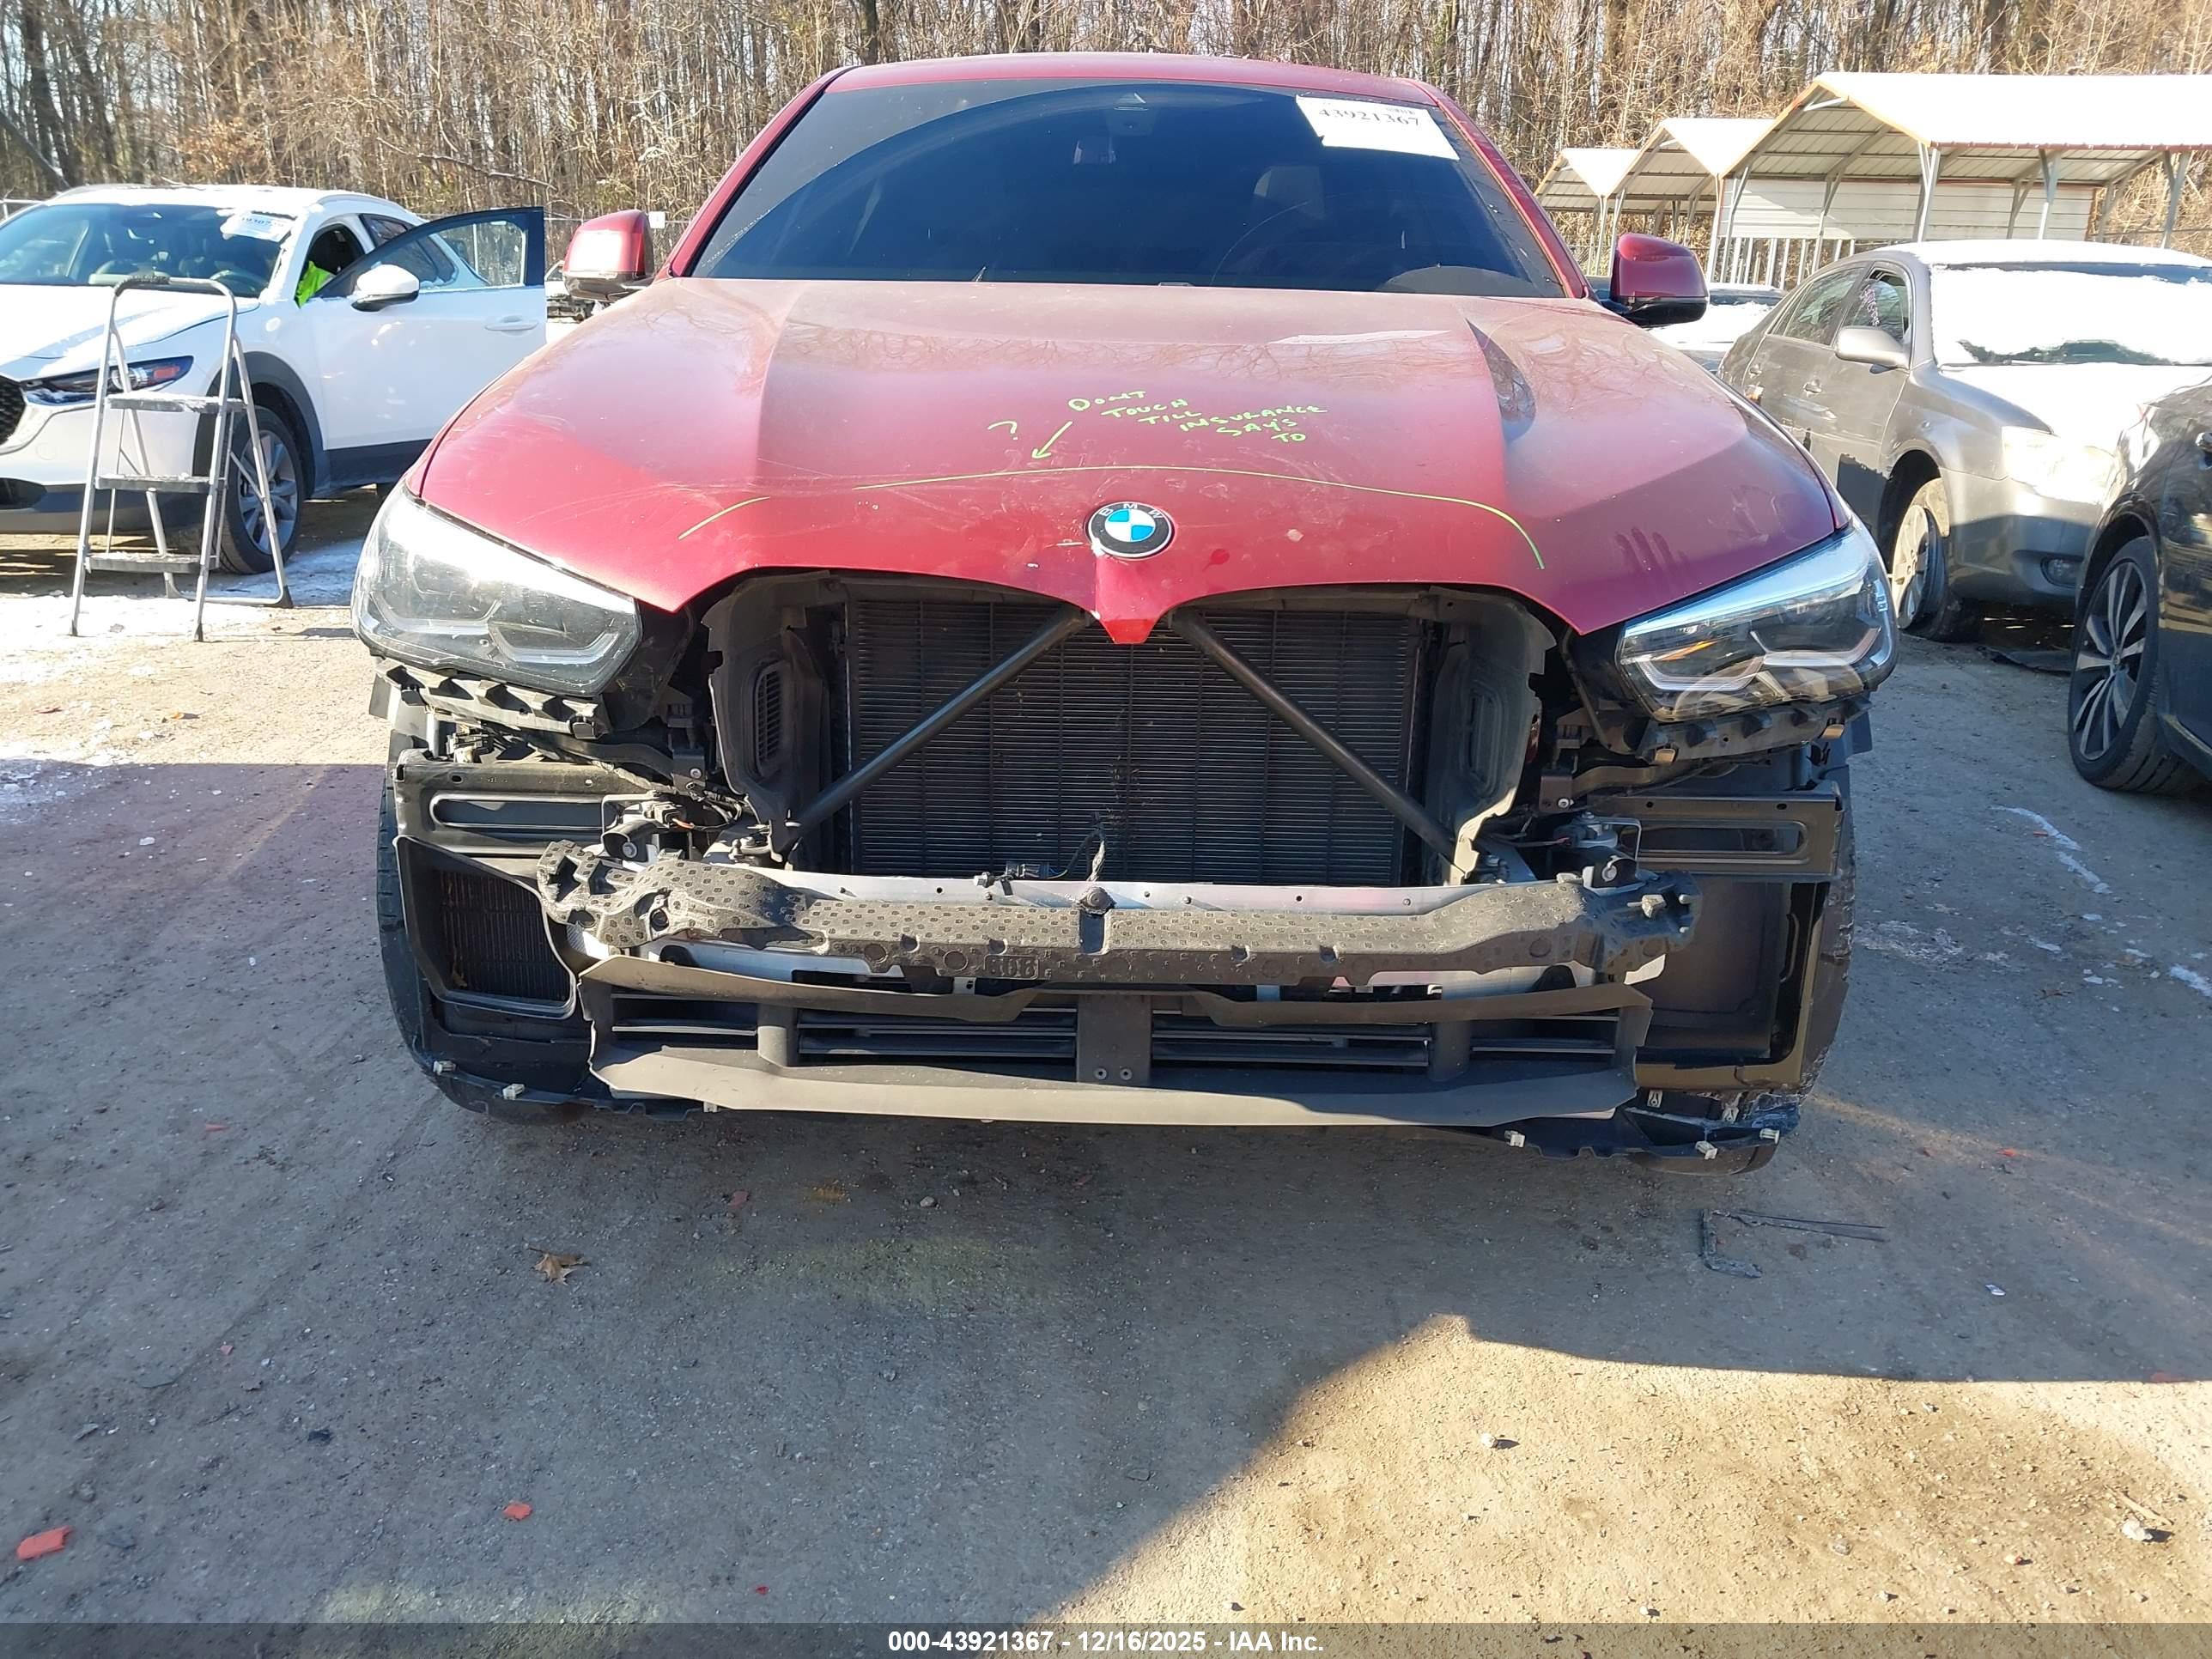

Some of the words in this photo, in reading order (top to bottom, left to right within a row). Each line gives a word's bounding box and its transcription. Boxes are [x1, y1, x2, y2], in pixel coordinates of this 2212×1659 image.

[1319, 108, 1419, 126] 43921367
[1100, 398, 1189, 418] TOUCH
[1137, 410, 1202, 425] TILL
[1179, 405, 1328, 432] INSURANCE
[1270, 433, 1306, 442] TO
[1098, 503, 1164, 519] BMW
